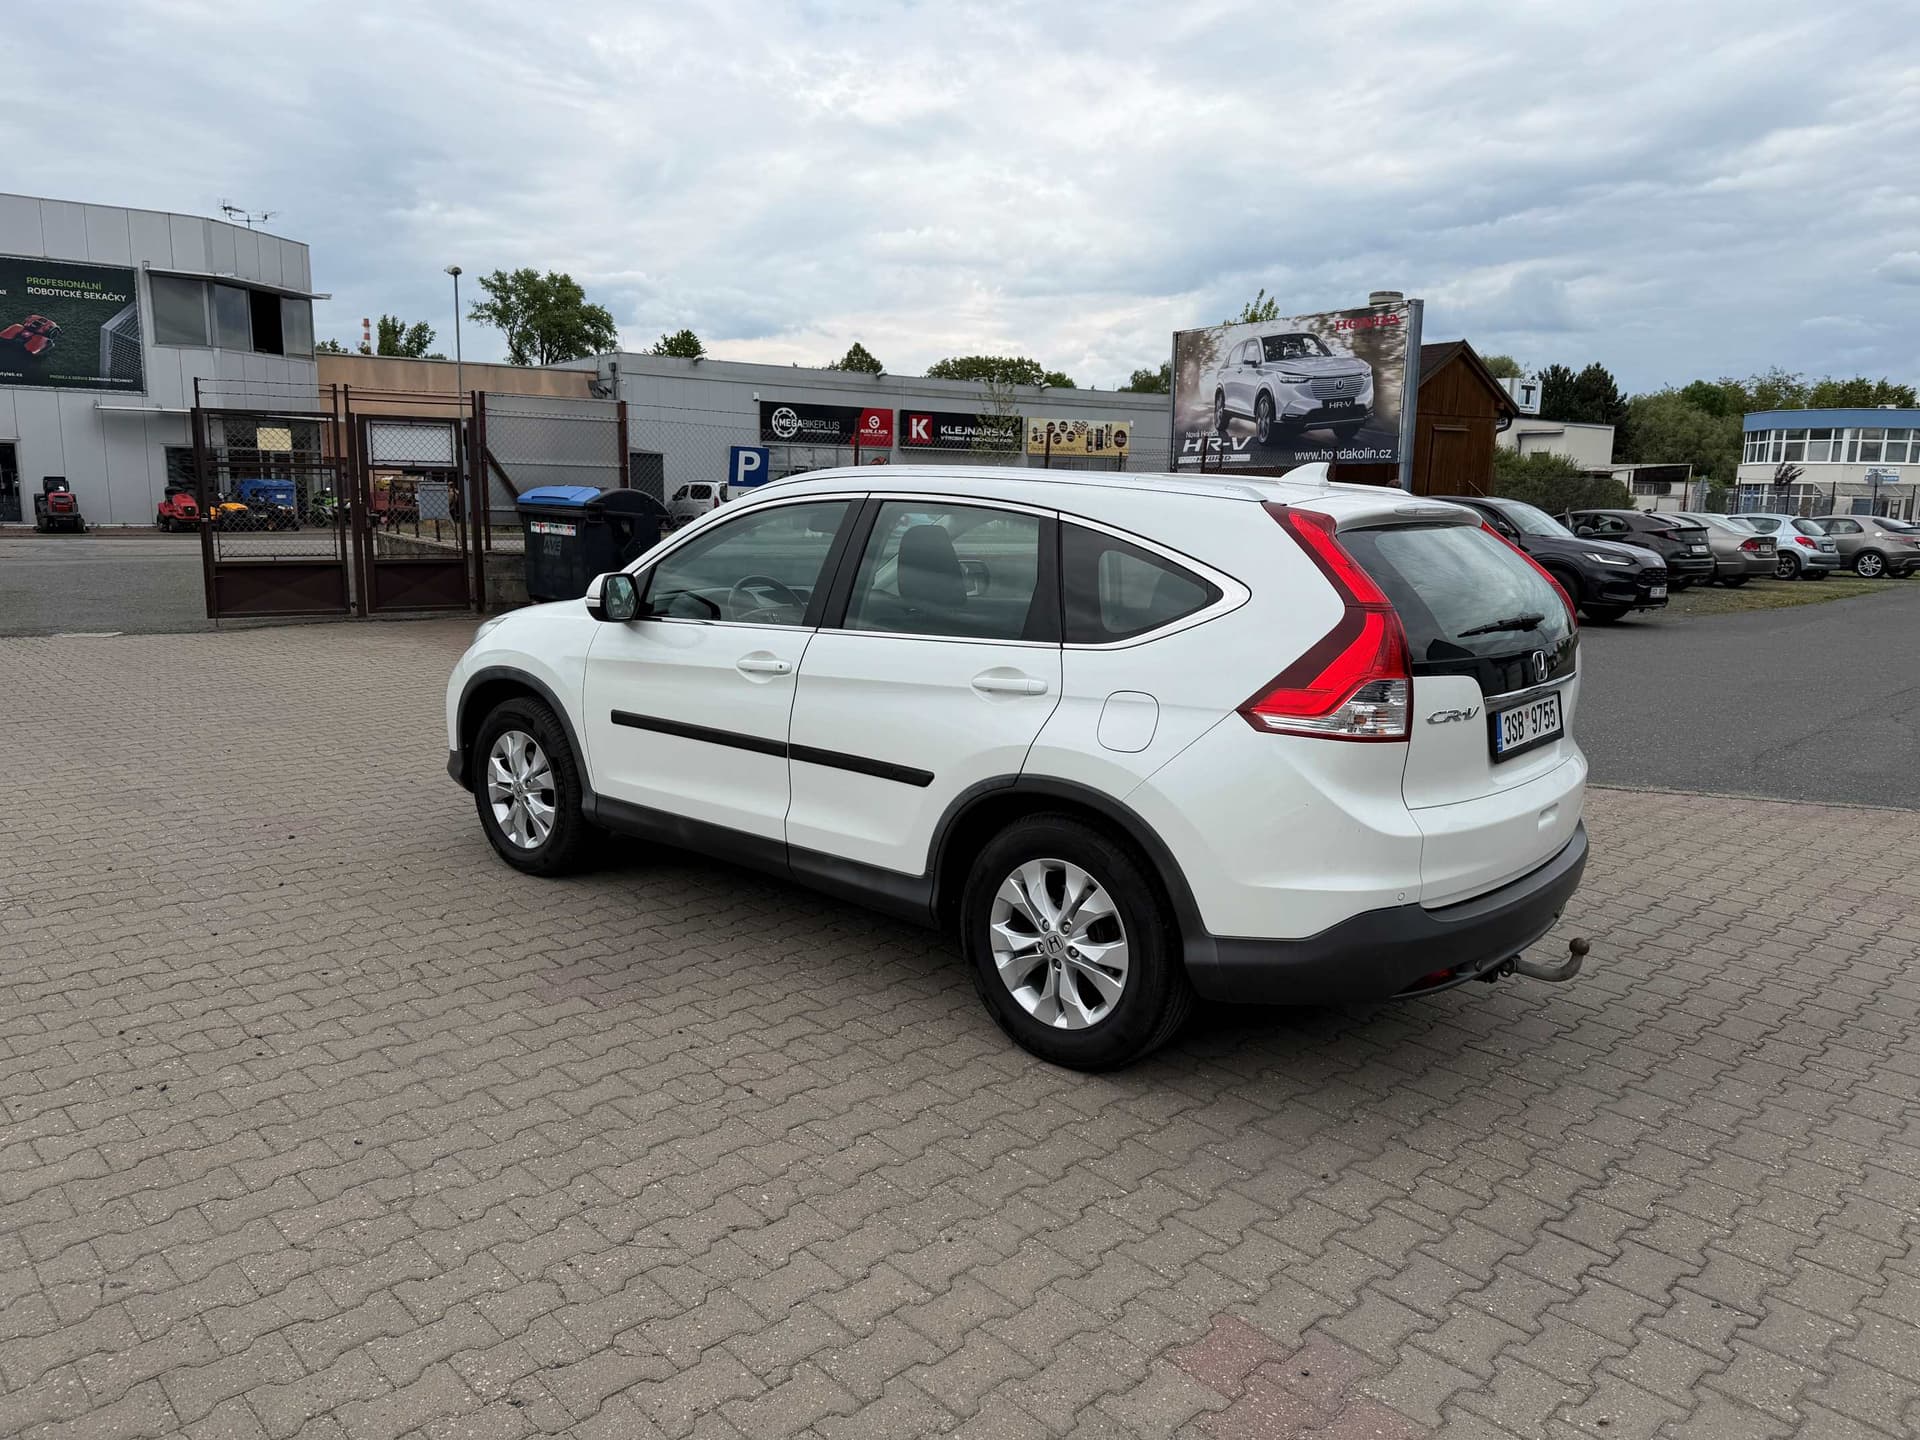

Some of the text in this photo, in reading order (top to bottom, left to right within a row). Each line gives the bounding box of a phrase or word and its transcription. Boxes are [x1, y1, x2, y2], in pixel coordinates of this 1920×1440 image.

[27, 286, 127, 302] ROBOTICKÉ SEKAČKY
[1334, 313, 1401, 332] HONDA
[1328, 400, 1352, 409] HR-V
[911, 418, 929, 440] K
[940, 425, 1014, 437] KLEJNARSKÁ
[1183, 436, 1252, 453] HR-V
[737, 450, 761, 482] P
[1426, 705, 1480, 725] CR-V
[1504, 699, 1556, 745] 3SB 9755
